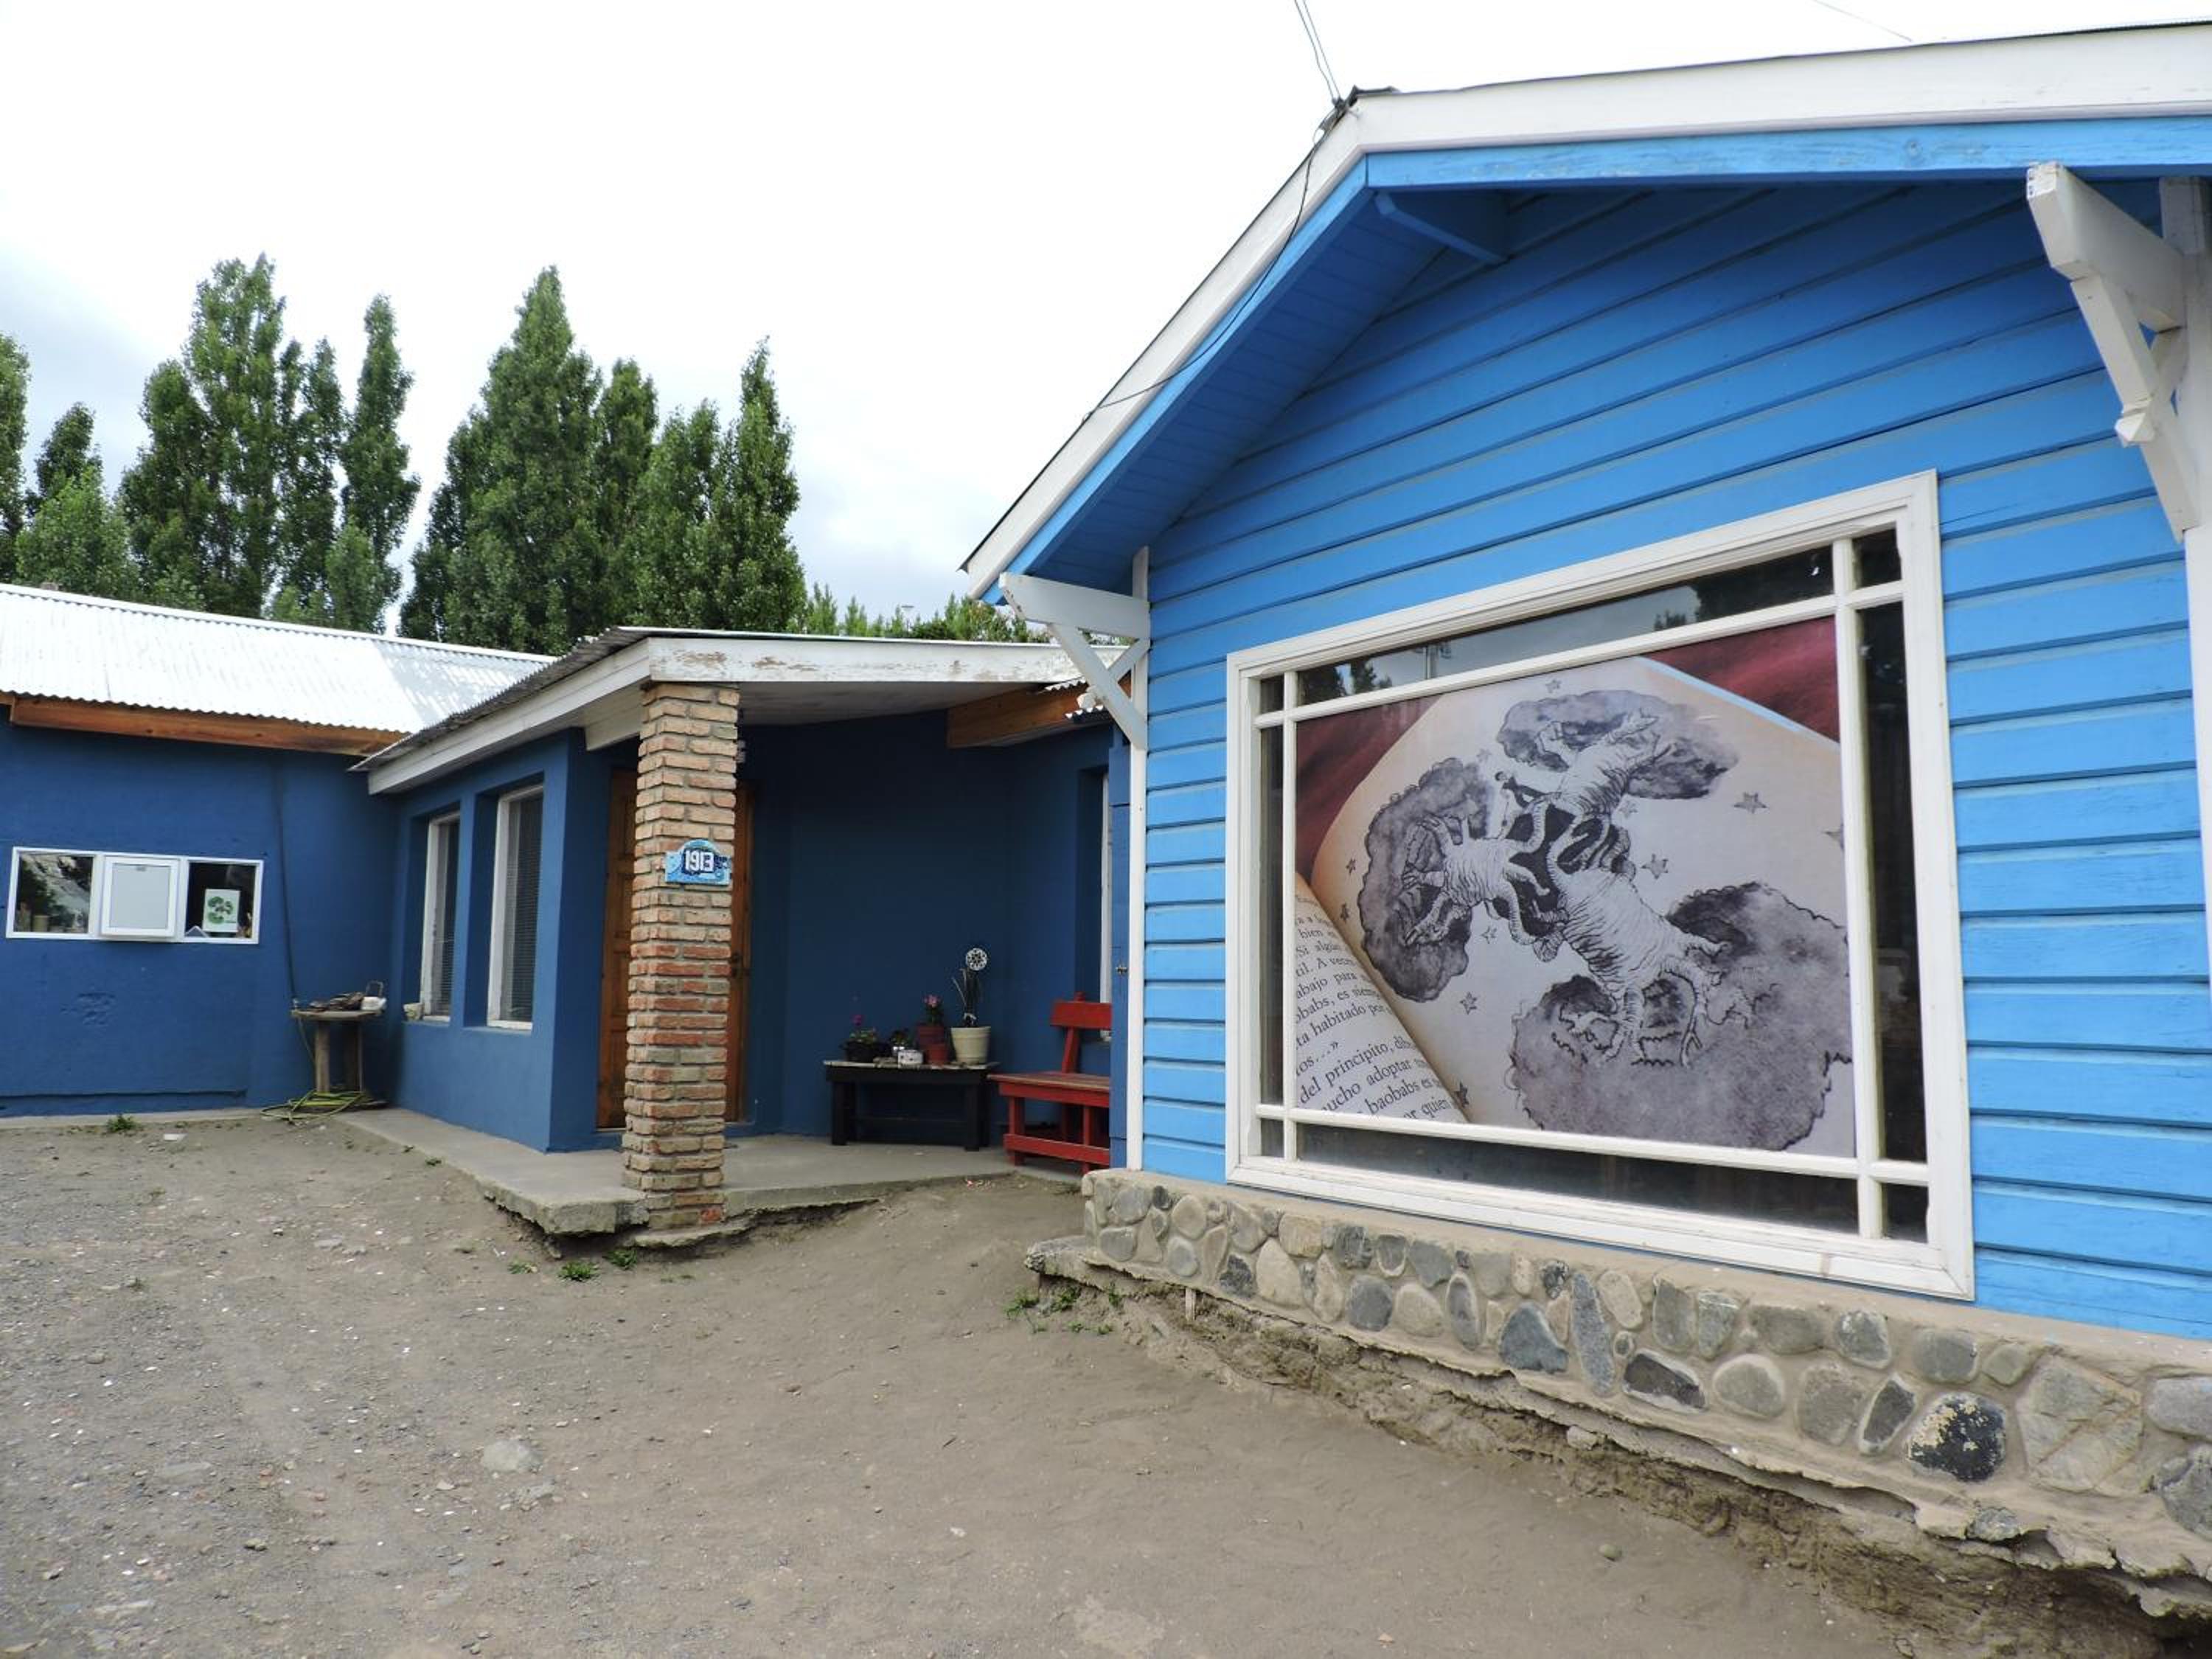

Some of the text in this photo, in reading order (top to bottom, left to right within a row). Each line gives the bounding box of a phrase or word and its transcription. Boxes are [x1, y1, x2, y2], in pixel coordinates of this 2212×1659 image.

[685, 850, 714, 872] 1913
[1316, 958, 1328, 970] A
[1337, 990, 1350, 1000] es
[1310, 1003, 1366, 1036] habitado
[1300, 1076, 1321, 1104] del
[1325, 1043, 1394, 1088] principito,
[1321, 1058, 1412, 1112] ucho adoptar
[1364, 1079, 1420, 1114] baobabs
